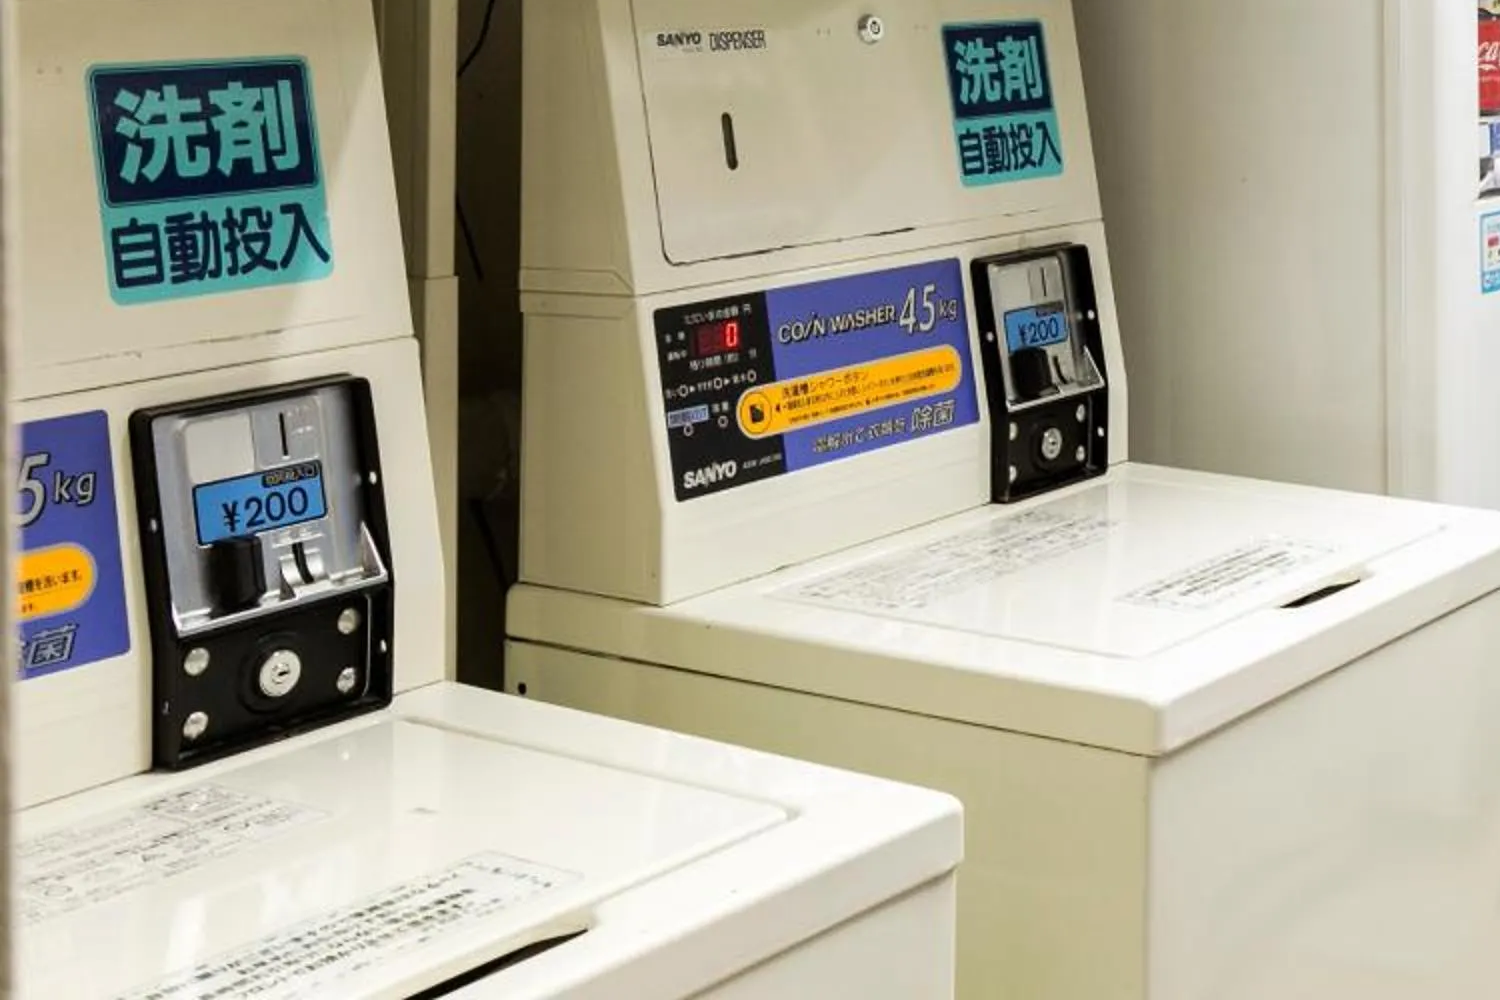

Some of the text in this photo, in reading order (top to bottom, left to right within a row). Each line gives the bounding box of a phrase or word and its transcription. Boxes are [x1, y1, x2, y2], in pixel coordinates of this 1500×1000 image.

[656, 30, 766, 52] SANYO DISPENSER
[954, 36, 1043, 104] 洗剤
[114, 80, 301, 184] 洗剤
[958, 120, 1062, 176] 自動投入
[111, 202, 331, 288] 自動投入
[725, 322, 738, 347] 0
[778, 316, 826, 344] COIN
[829, 304, 896, 332] WASHER
[1017, 316, 1059, 345] ¥200
[54, 471, 95, 505] kg
[683, 460, 737, 489] SANYO
[221, 486, 309, 534] ¥200
